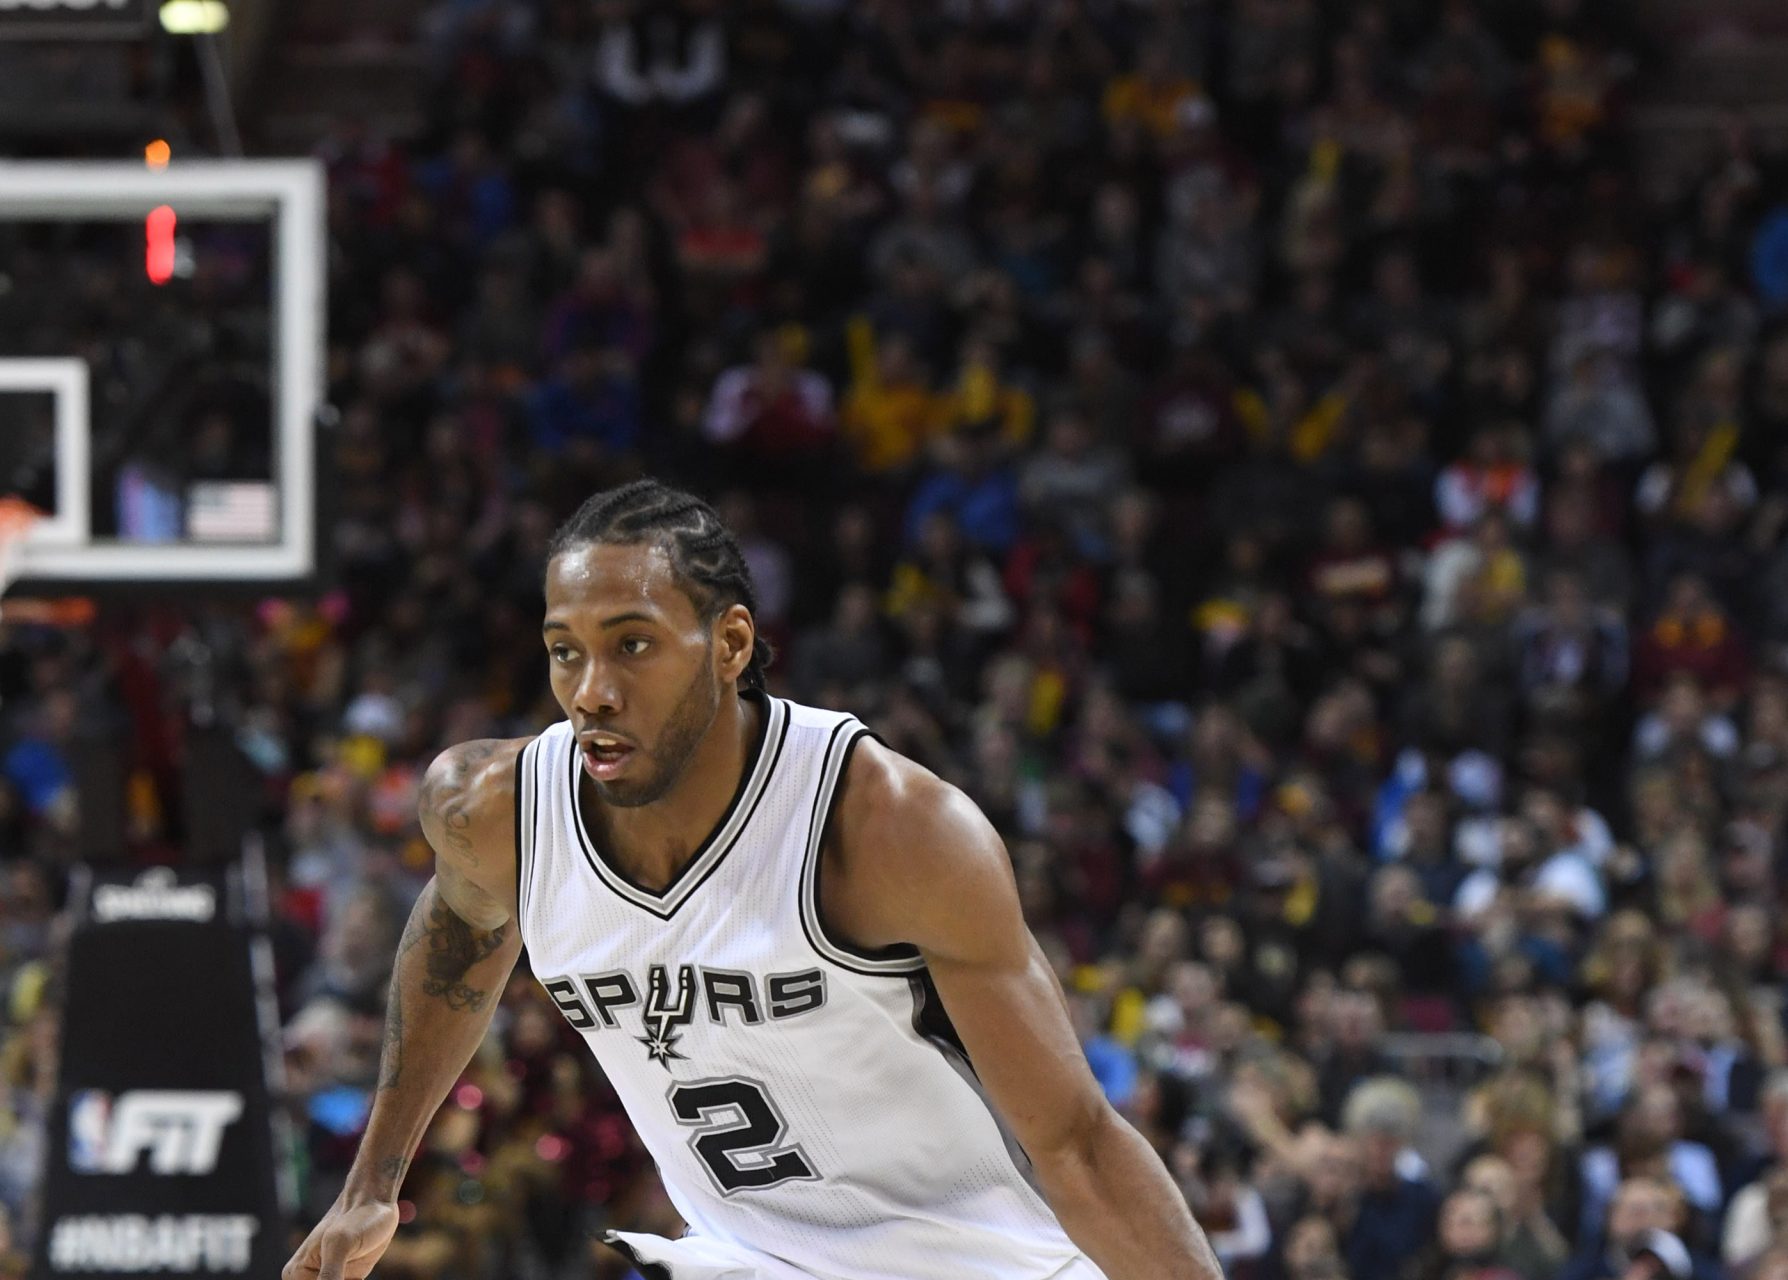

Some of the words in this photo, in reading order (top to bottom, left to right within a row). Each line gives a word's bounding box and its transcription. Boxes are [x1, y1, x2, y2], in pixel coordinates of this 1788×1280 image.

[541, 963, 828, 1042] SPURS
[665, 1074, 824, 1198] 2
[51, 1215, 259, 1272] #NBAFIT
